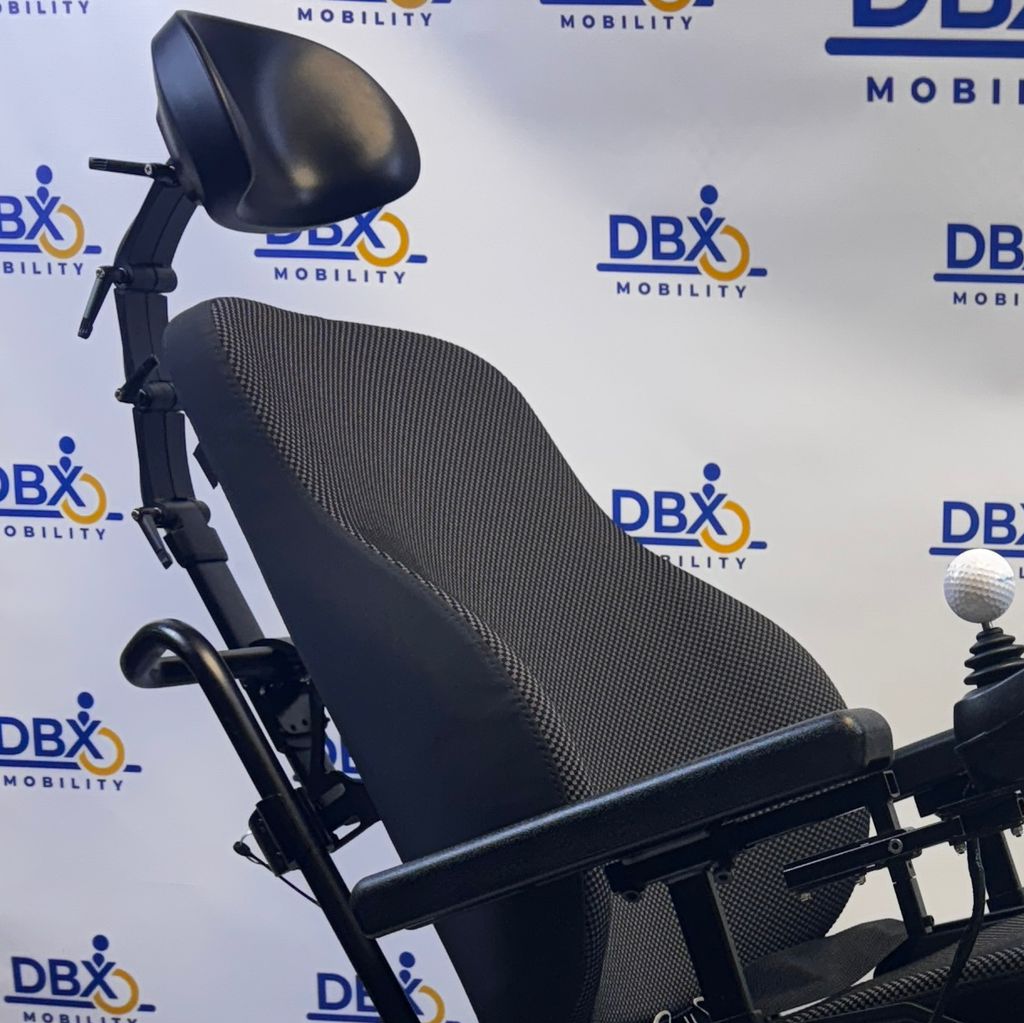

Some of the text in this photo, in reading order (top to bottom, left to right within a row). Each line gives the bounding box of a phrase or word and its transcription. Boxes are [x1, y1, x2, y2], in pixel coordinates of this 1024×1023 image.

[0, 0, 89, 14] BILITY
[298, 7, 432, 27] MOBILITY
[561, 15, 692, 30] MOBILITY
[0, 195, 64, 240] BX
[609, 214, 727, 262] DBX
[3, 261, 83, 275] BILITY
[274, 267, 405, 284] MOBILITY
[617, 282, 746, 298] MOBILITY
[612, 489, 728, 535] DBX
[4, 525, 105, 540] OBILITY
[659, 555, 746, 569] ILITY
[0, 716, 104, 759] DBX
[4, 775, 123, 791] MOBILITY
[11, 956, 118, 999] DBX
